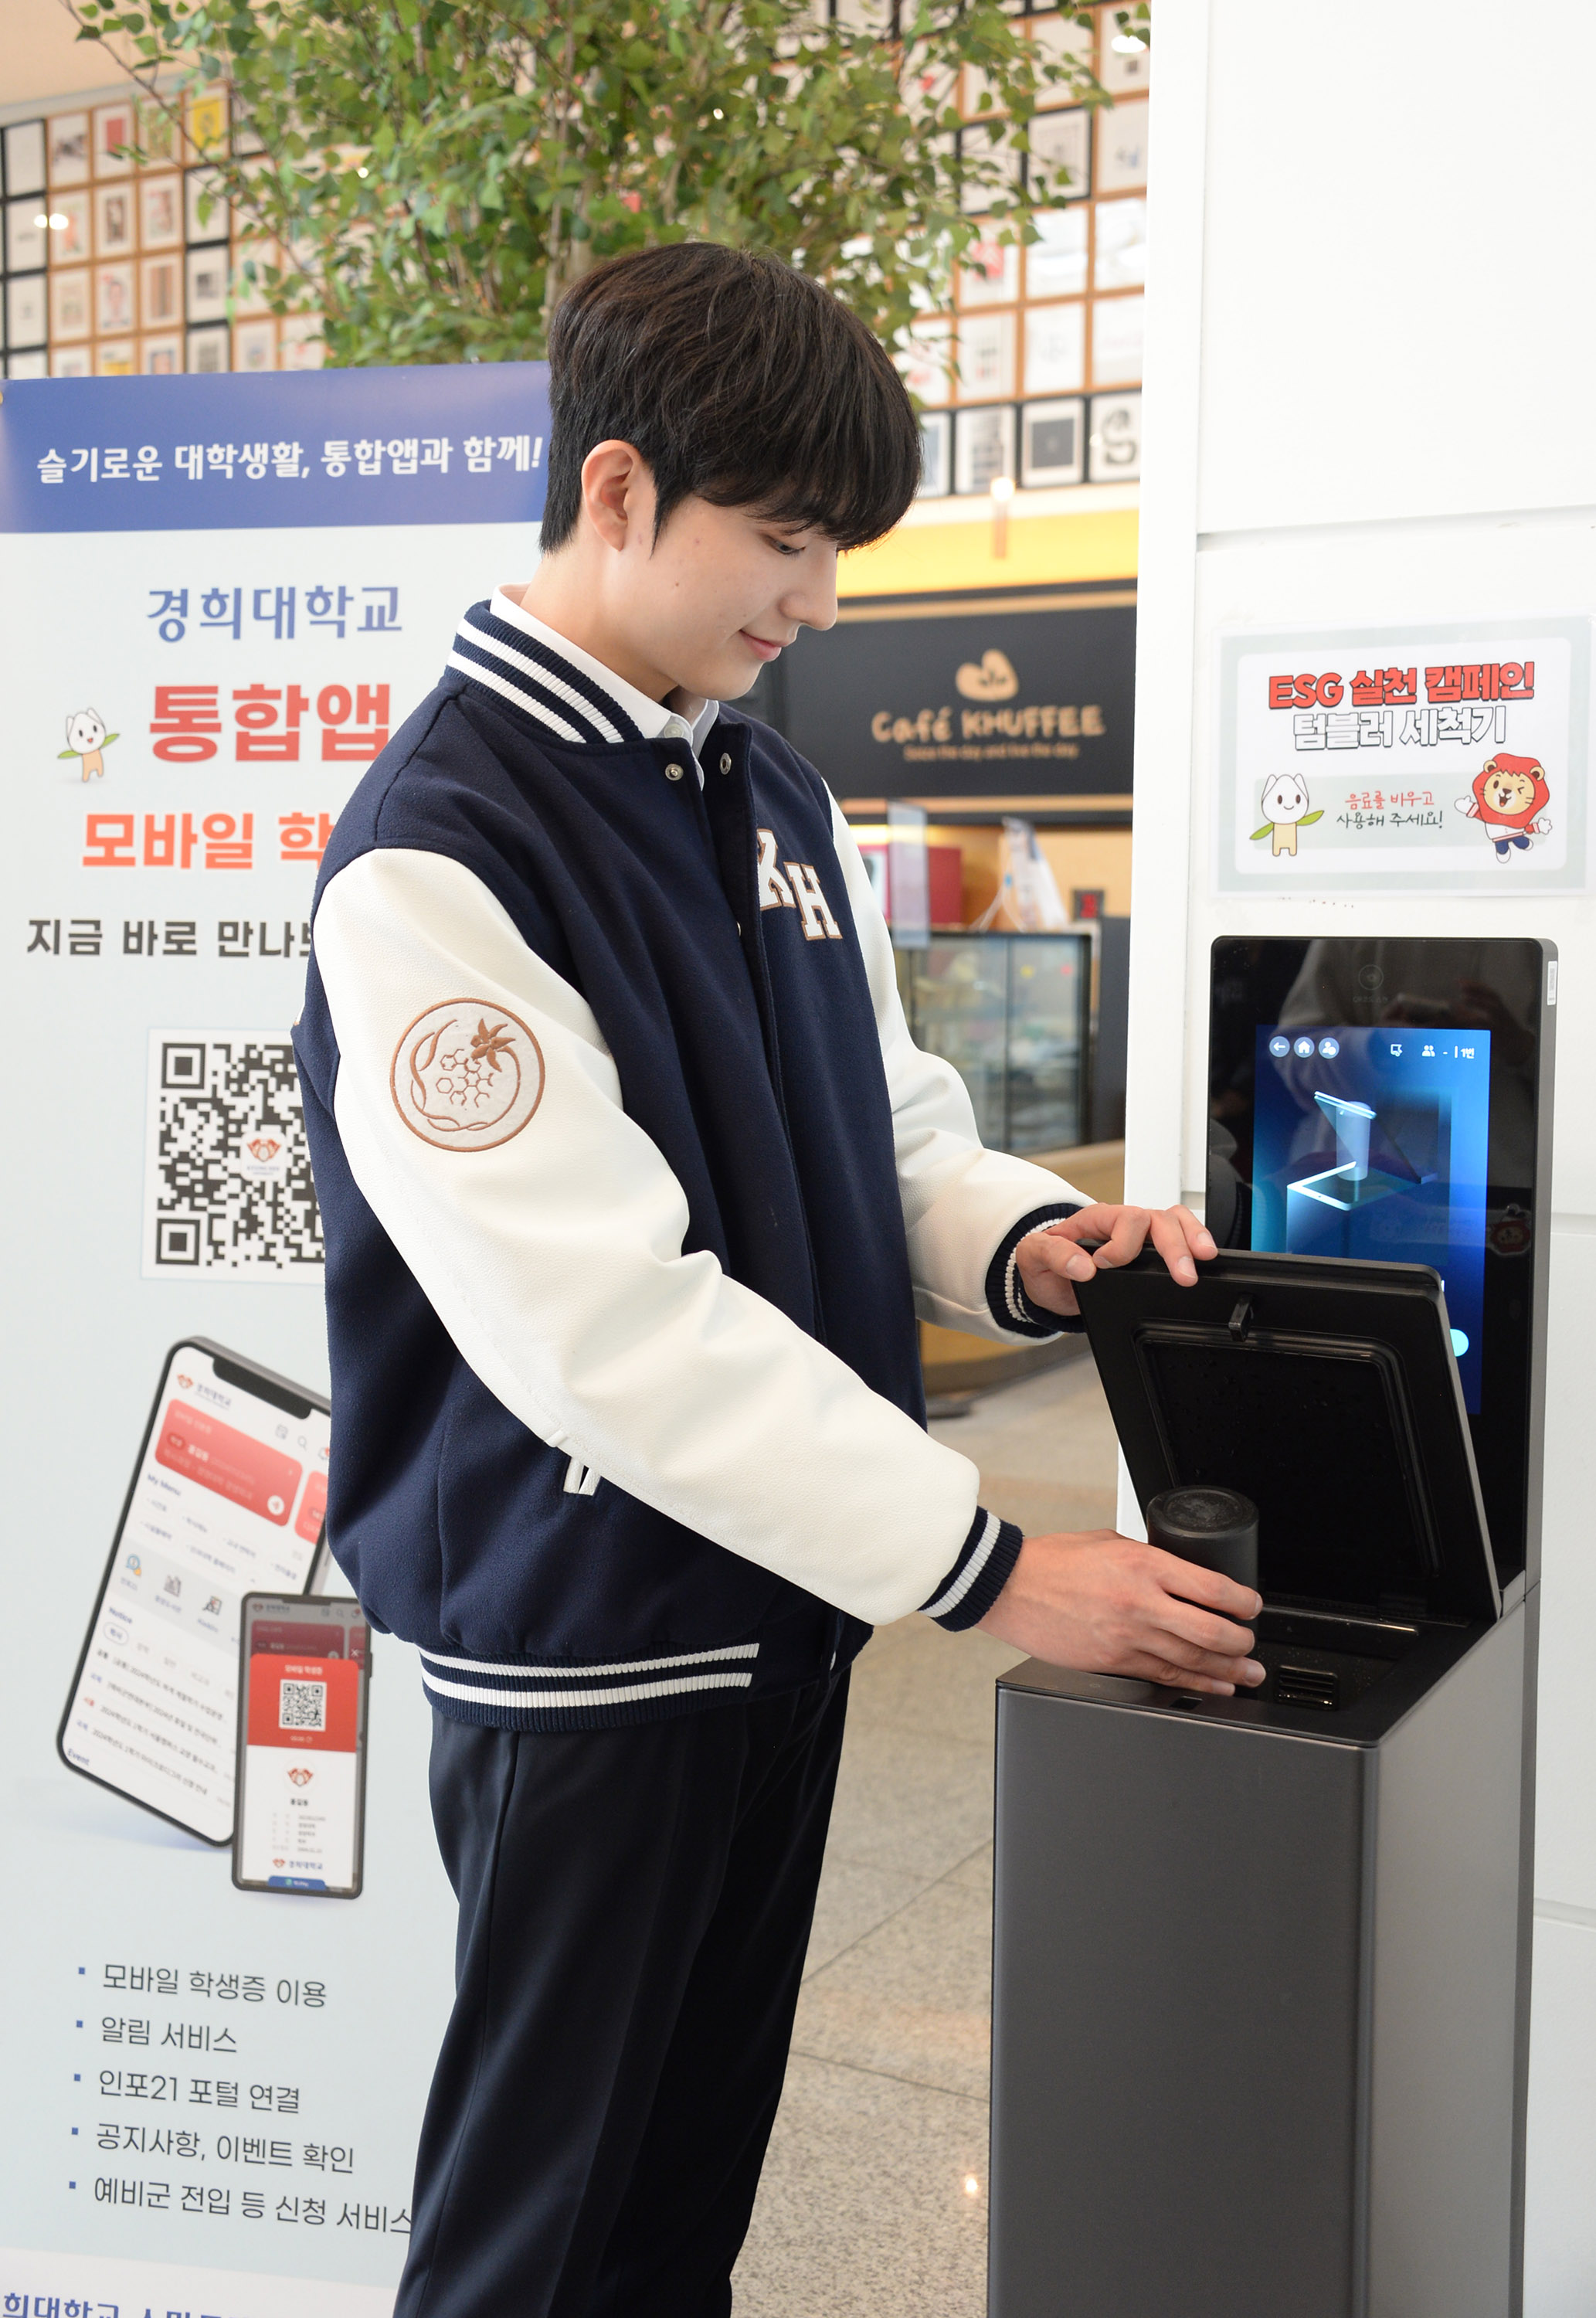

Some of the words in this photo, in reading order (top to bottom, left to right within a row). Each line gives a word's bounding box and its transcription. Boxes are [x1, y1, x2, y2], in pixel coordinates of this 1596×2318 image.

[37, 446, 163, 484] 슬기로운
[174, 442, 311, 479] 대학생활,
[320, 438, 453, 478] 통합앱과
[463, 435, 543, 473] 함께!
[147, 585, 402, 643] 경희대학교
[1268, 672, 1343, 709] ESG
[1350, 667, 1417, 707] 실천
[1425, 661, 1535, 703] 캠페인
[150, 683, 391, 763] 통합앱
[871, 706, 953, 743] Café
[961, 705, 1105, 739] KHUFFEE
[1293, 710, 1393, 751] 텀블러
[1400, 705, 1506, 746] 세척기
[1336, 811, 1385, 830] 사용해
[1389, 811, 1443, 829] 주세요!
[1345, 790, 1385, 811] 음료를
[82, 813, 253, 870] 모바일
[26, 919, 103, 957] 지금
[122, 921, 198, 957] 바로
[1461, 1048, 1475, 1059] 1번
[68, 1749, 90, 1766] Event
[103, 1963, 179, 1995] 모바일
[188, 1970, 267, 2003] 학생증
[276, 1980, 328, 2008] 이용
[101, 2017, 151, 2046] 알림
[161, 2023, 237, 2053] 서비스
[99, 2070, 179, 2102] 인포21
[188, 2078, 239, 2109] 포털
[249, 2084, 301, 2114] 연결
[96, 2123, 206, 2161] 공지사항,
[216, 2136, 293, 2167] 이벤트
[302, 2143, 355, 2174] 확인
[94, 2177, 171, 2210] 예비군
[180, 2186, 231, 2216] 전입
[241, 2191, 266, 2221] 등
[275, 2197, 326, 2226] 신청
[337, 2203, 412, 2235] 서비스
